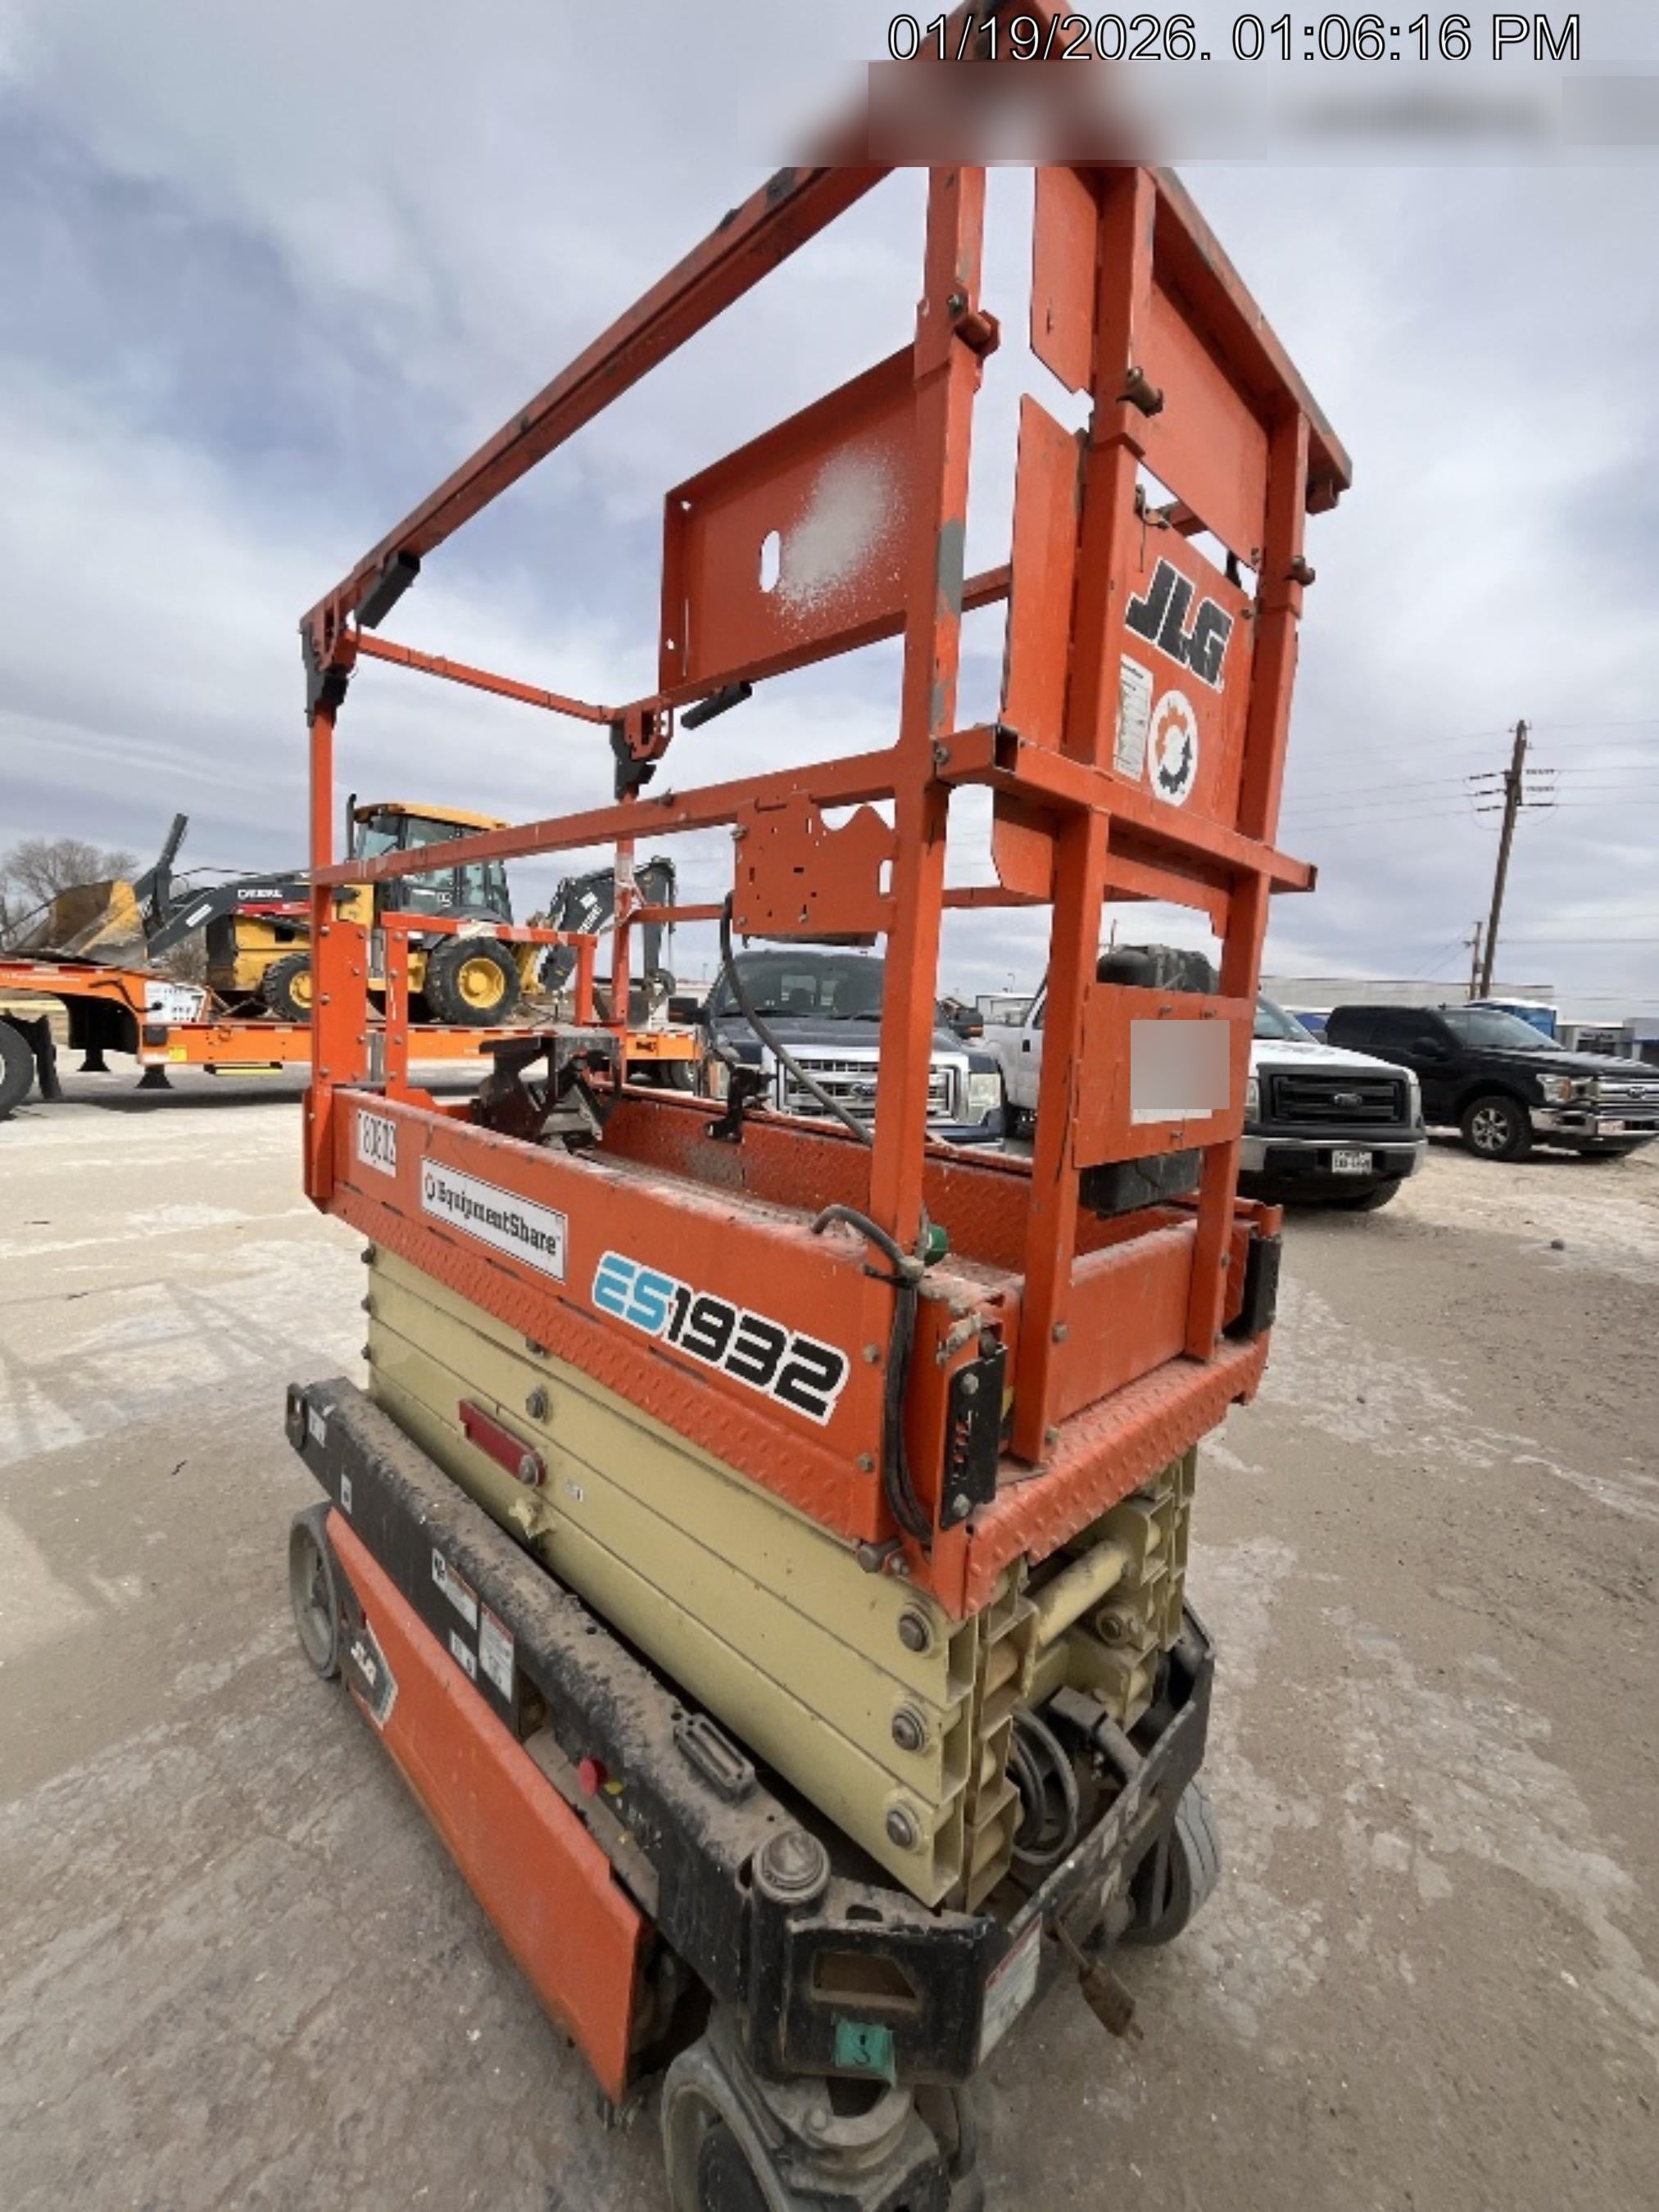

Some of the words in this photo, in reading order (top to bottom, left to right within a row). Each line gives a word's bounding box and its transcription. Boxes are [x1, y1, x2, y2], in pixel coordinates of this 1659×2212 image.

[1126, 556, 1235, 693] JLG
[437, 1180, 556, 1256] EquipmentShare
[592, 1252, 850, 1425] ES1932
